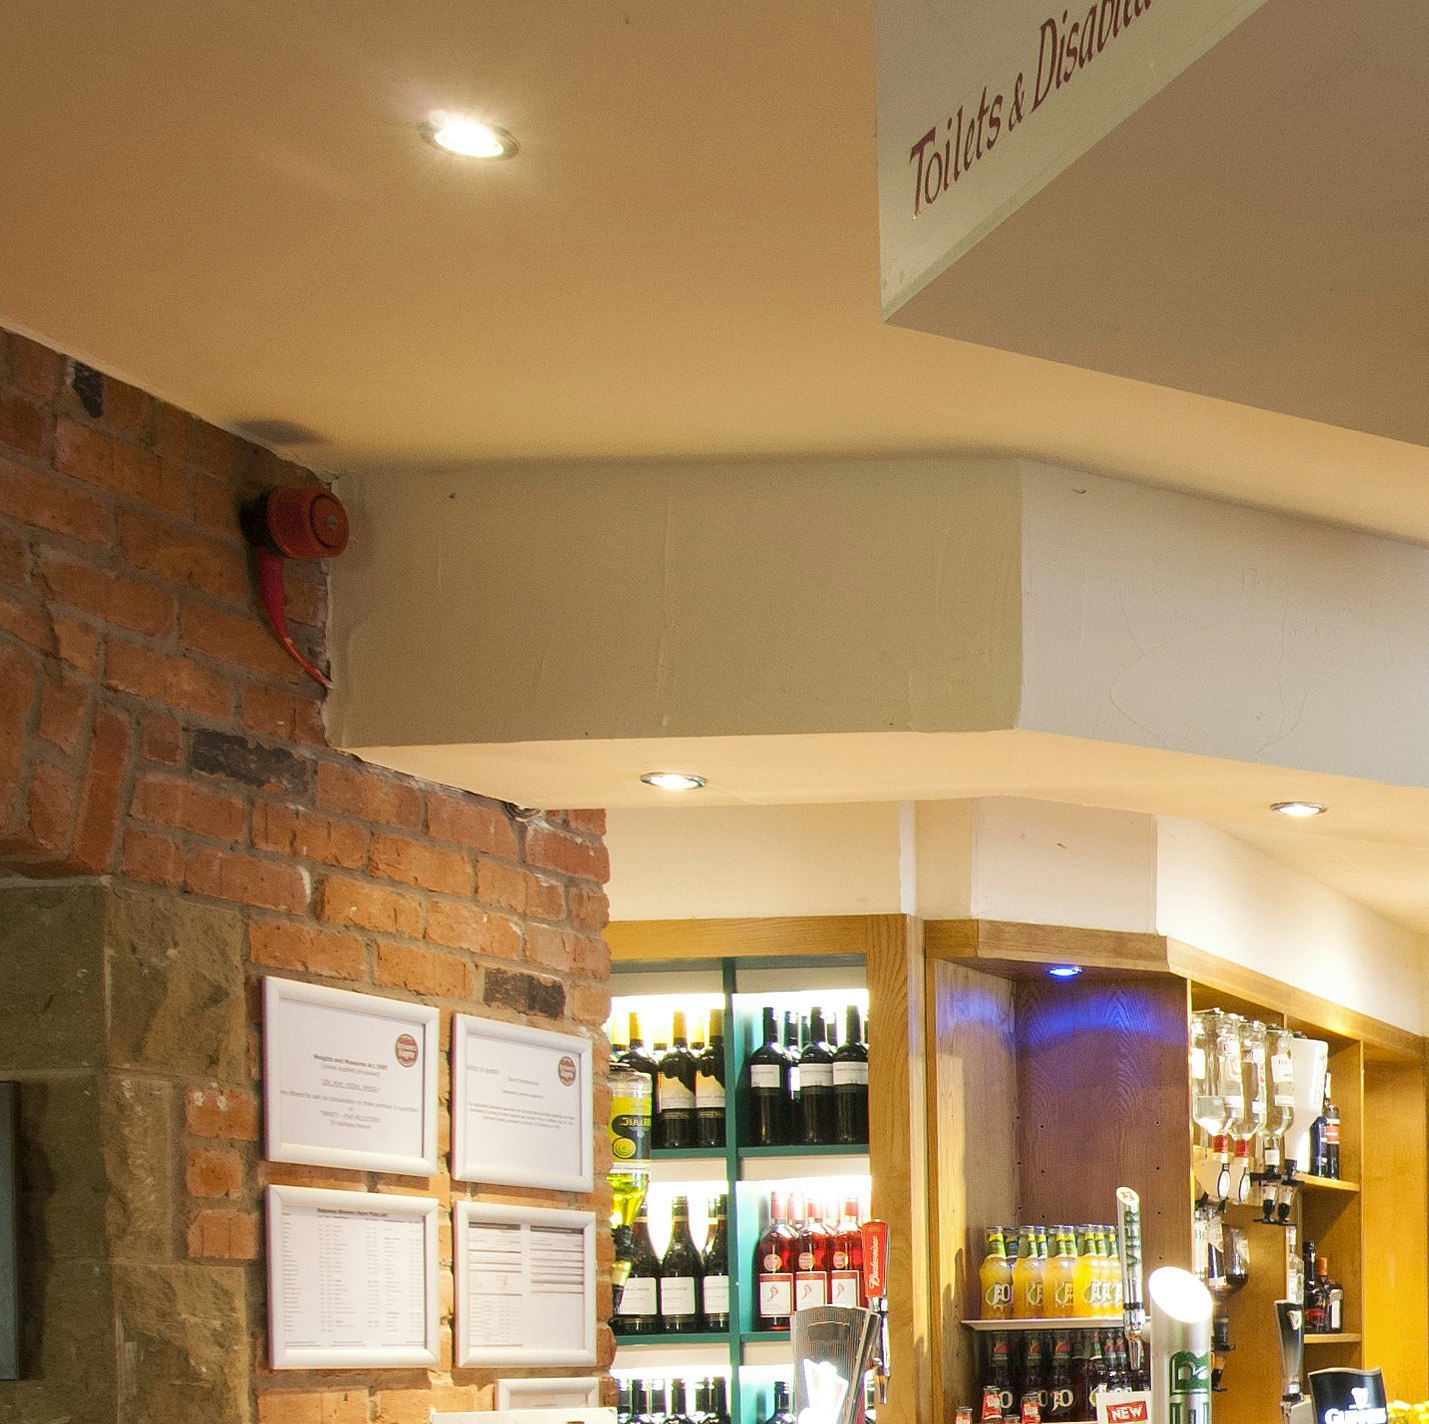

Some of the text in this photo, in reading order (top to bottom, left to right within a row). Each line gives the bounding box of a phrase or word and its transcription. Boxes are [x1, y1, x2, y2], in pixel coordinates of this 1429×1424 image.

[909, 86, 1004, 215] Toilets
[1008, 72, 1026, 132] &
[1111, 1404, 1143, 1421] NEW
